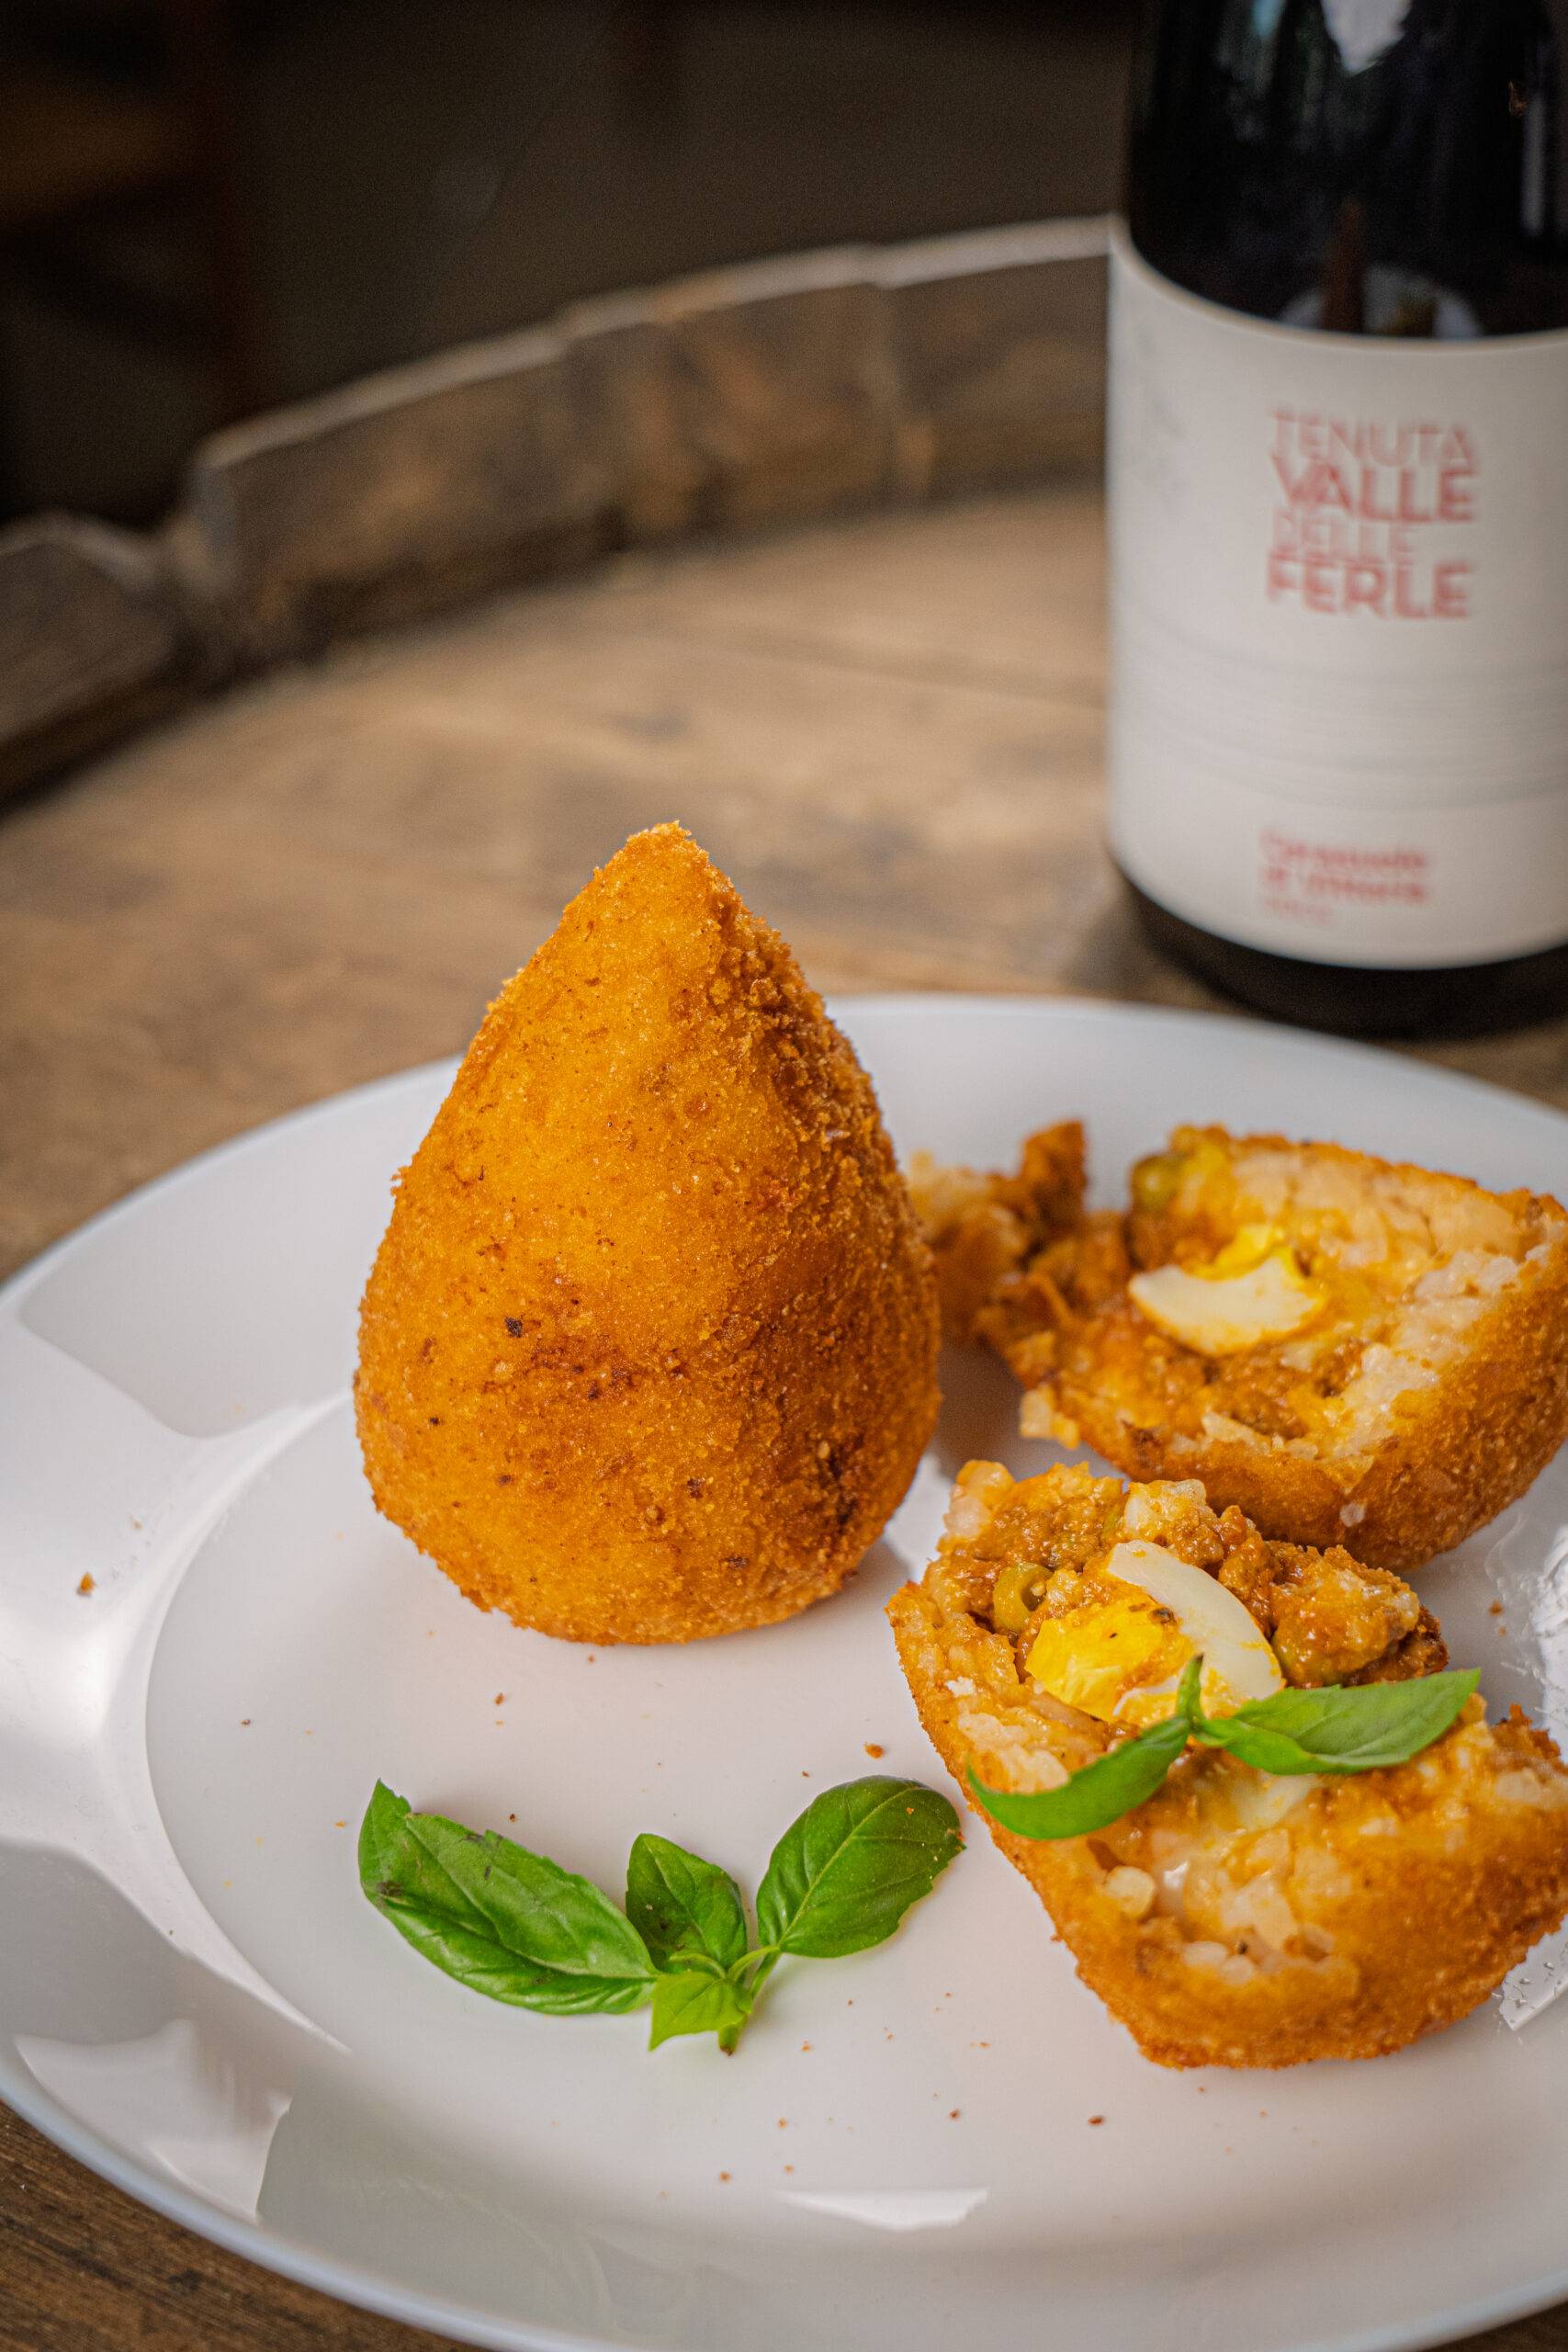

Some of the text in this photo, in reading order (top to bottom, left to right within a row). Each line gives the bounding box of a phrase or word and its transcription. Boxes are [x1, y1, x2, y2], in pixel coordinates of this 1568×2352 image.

[1271, 411, 1479, 467] TENUTA
[1271, 455, 1478, 524] VALLE
[1269, 553, 1473, 618] FERLE
